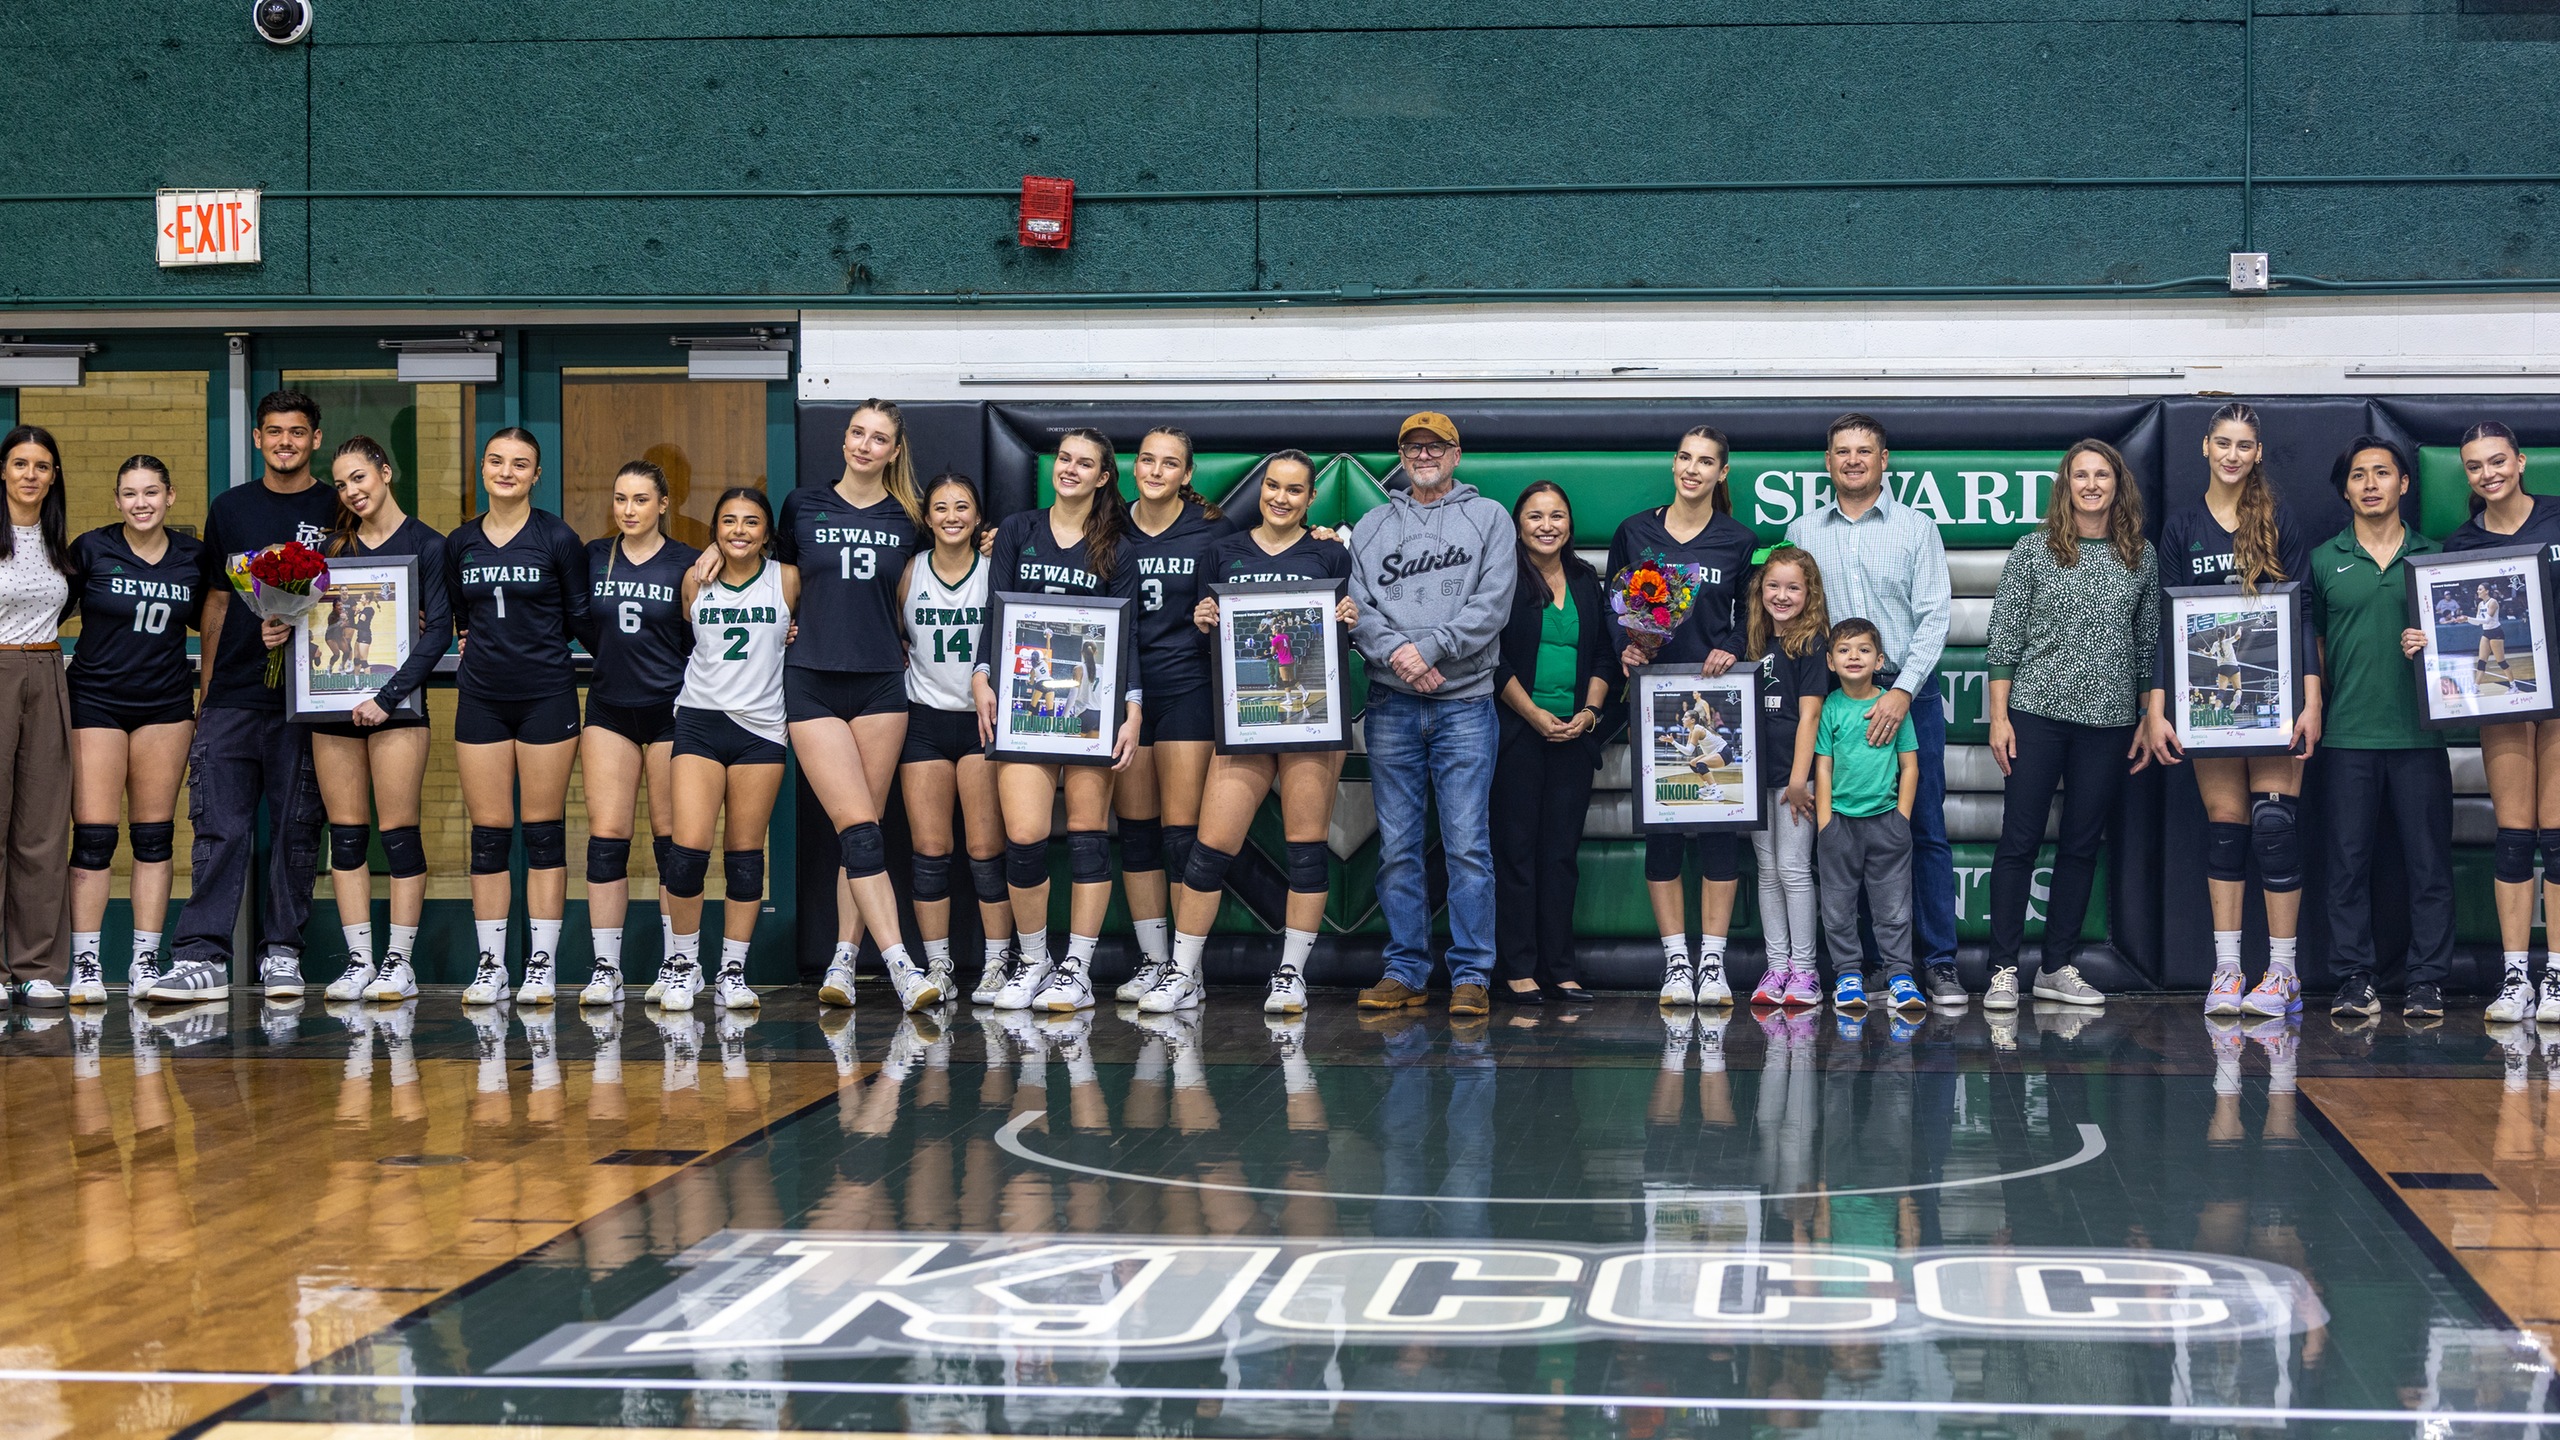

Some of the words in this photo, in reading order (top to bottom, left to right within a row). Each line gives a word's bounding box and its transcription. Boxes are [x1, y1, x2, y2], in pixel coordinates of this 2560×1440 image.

[177, 202, 242, 255] EXIT
[814, 528, 901, 548] SEWARD
[461, 565, 541, 584] SEWARD
[839, 546, 877, 580] 13
[1377, 544, 1473, 587] Saints
[1020, 563, 1098, 590] SEWARD
[1440, 578, 1465, 597] 67
[111, 577, 190, 602] SEWARD
[594, 580, 674, 602] SEWARD
[1141, 578, 1163, 611] 3
[1384, 584, 1404, 601] 19
[493, 586, 506, 618] 1
[133, 600, 171, 634] 10
[618, 600, 643, 634] 6
[698, 606, 777, 625] SEWARD
[723, 627, 750, 660] 2
[933, 628, 973, 663] 14
[310, 673, 356, 690] EDUARDA
[1013, 714, 1082, 734] MILIVOJEVIC
[1239, 705, 1279, 724] VUKOV
[2189, 708, 2235, 727] CHAVES
[1655, 783, 1700, 801] NIKOLIC
